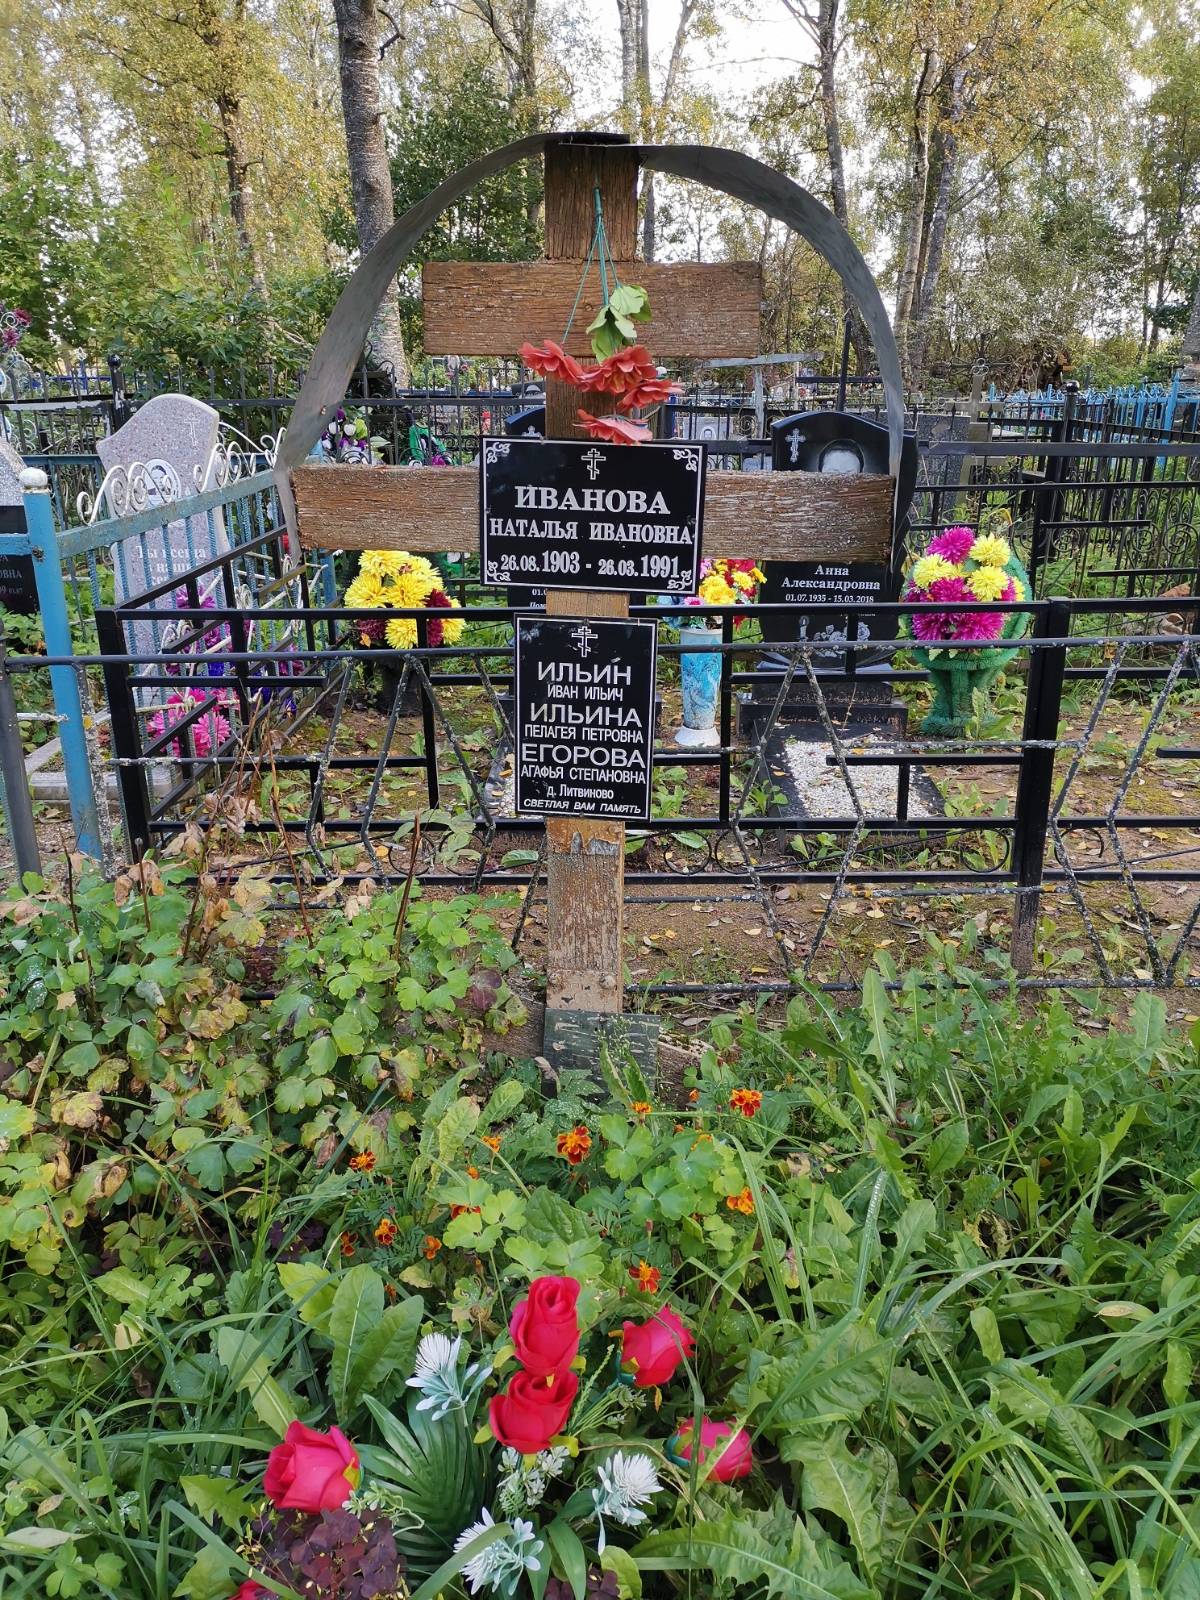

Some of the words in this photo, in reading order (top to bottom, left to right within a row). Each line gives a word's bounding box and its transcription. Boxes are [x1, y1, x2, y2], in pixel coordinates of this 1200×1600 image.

[514, 485, 671, 515] ИВАНОВА
[489, 518, 579, 540] НАТАЛЬЯ
[589, 522, 693, 545] ИВАНОВНА
[500, 550, 580, 574] 26.08.1903
[597, 554, 680, 578] 26.03.1991
[814, 564, 849, 576] Анна
[781, 576, 880, 591] Александровна
[785, 593, 827, 602] 01.07.1935
[833, 594, 874, 603] 15.03.2018
[538, 661, 631, 686] ИЛЬИН
[547, 684, 579, 699] ИВАН
[584, 686, 624, 702] ИЛЬИЧ
[530, 702, 643, 728] ИЛЬИНА
[524, 724, 576, 740] ПЕЛАГЕЯ
[582, 727, 644, 744] ПЕТРОВНА
[521, 742, 646, 769] ЕГОРОВА
[520, 764, 564, 779] АГАФЬЯ
[569, 767, 647, 784] СТЕПАНОВНА
[523, 798, 569, 809] СВЕТЛАЯ
[573, 802, 596, 811] ВАМ
[600, 803, 641, 814] ПАМЯТЬ
